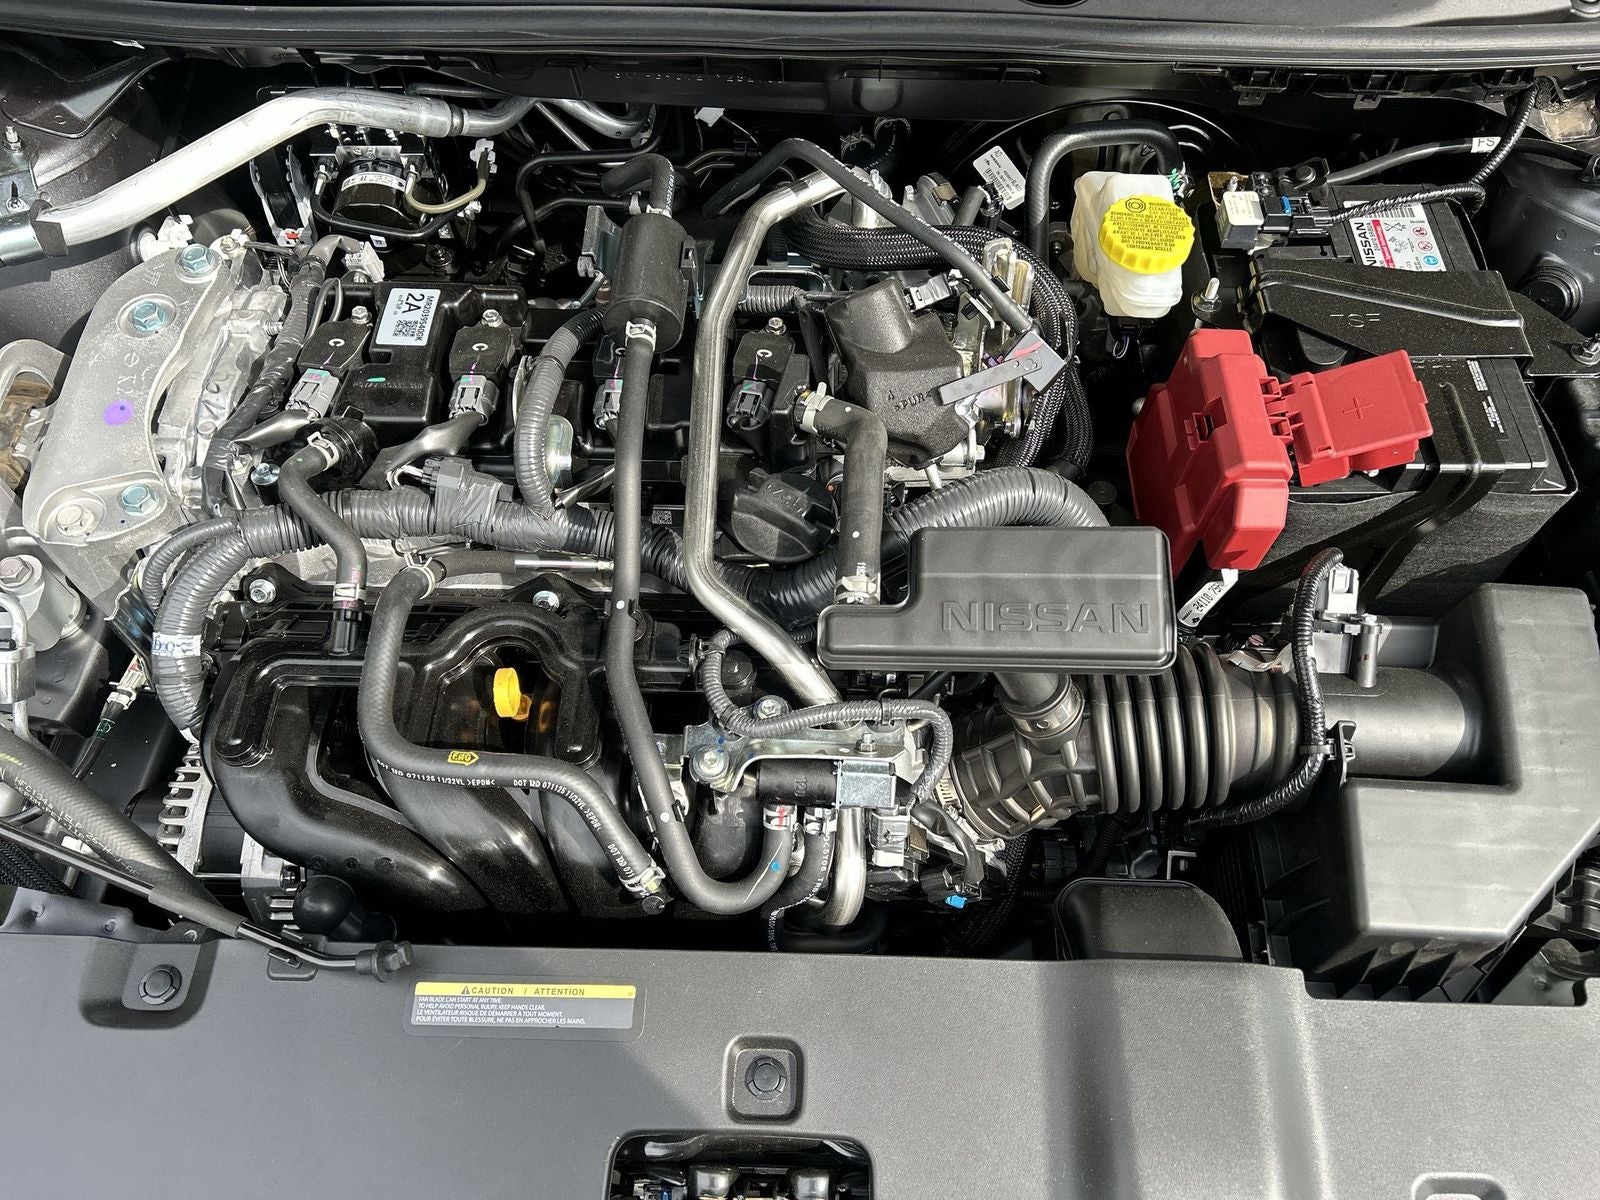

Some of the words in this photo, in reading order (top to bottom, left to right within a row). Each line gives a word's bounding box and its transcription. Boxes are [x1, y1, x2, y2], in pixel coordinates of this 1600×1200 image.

[402, 292, 425, 314] 2A
[941, 602, 1150, 634] NISSAN
[406, 772, 436, 782] 071125
[542, 781, 567, 794] 071125
[608, 844, 620, 856] DOT
[471, 987, 514, 995] CAUTION
